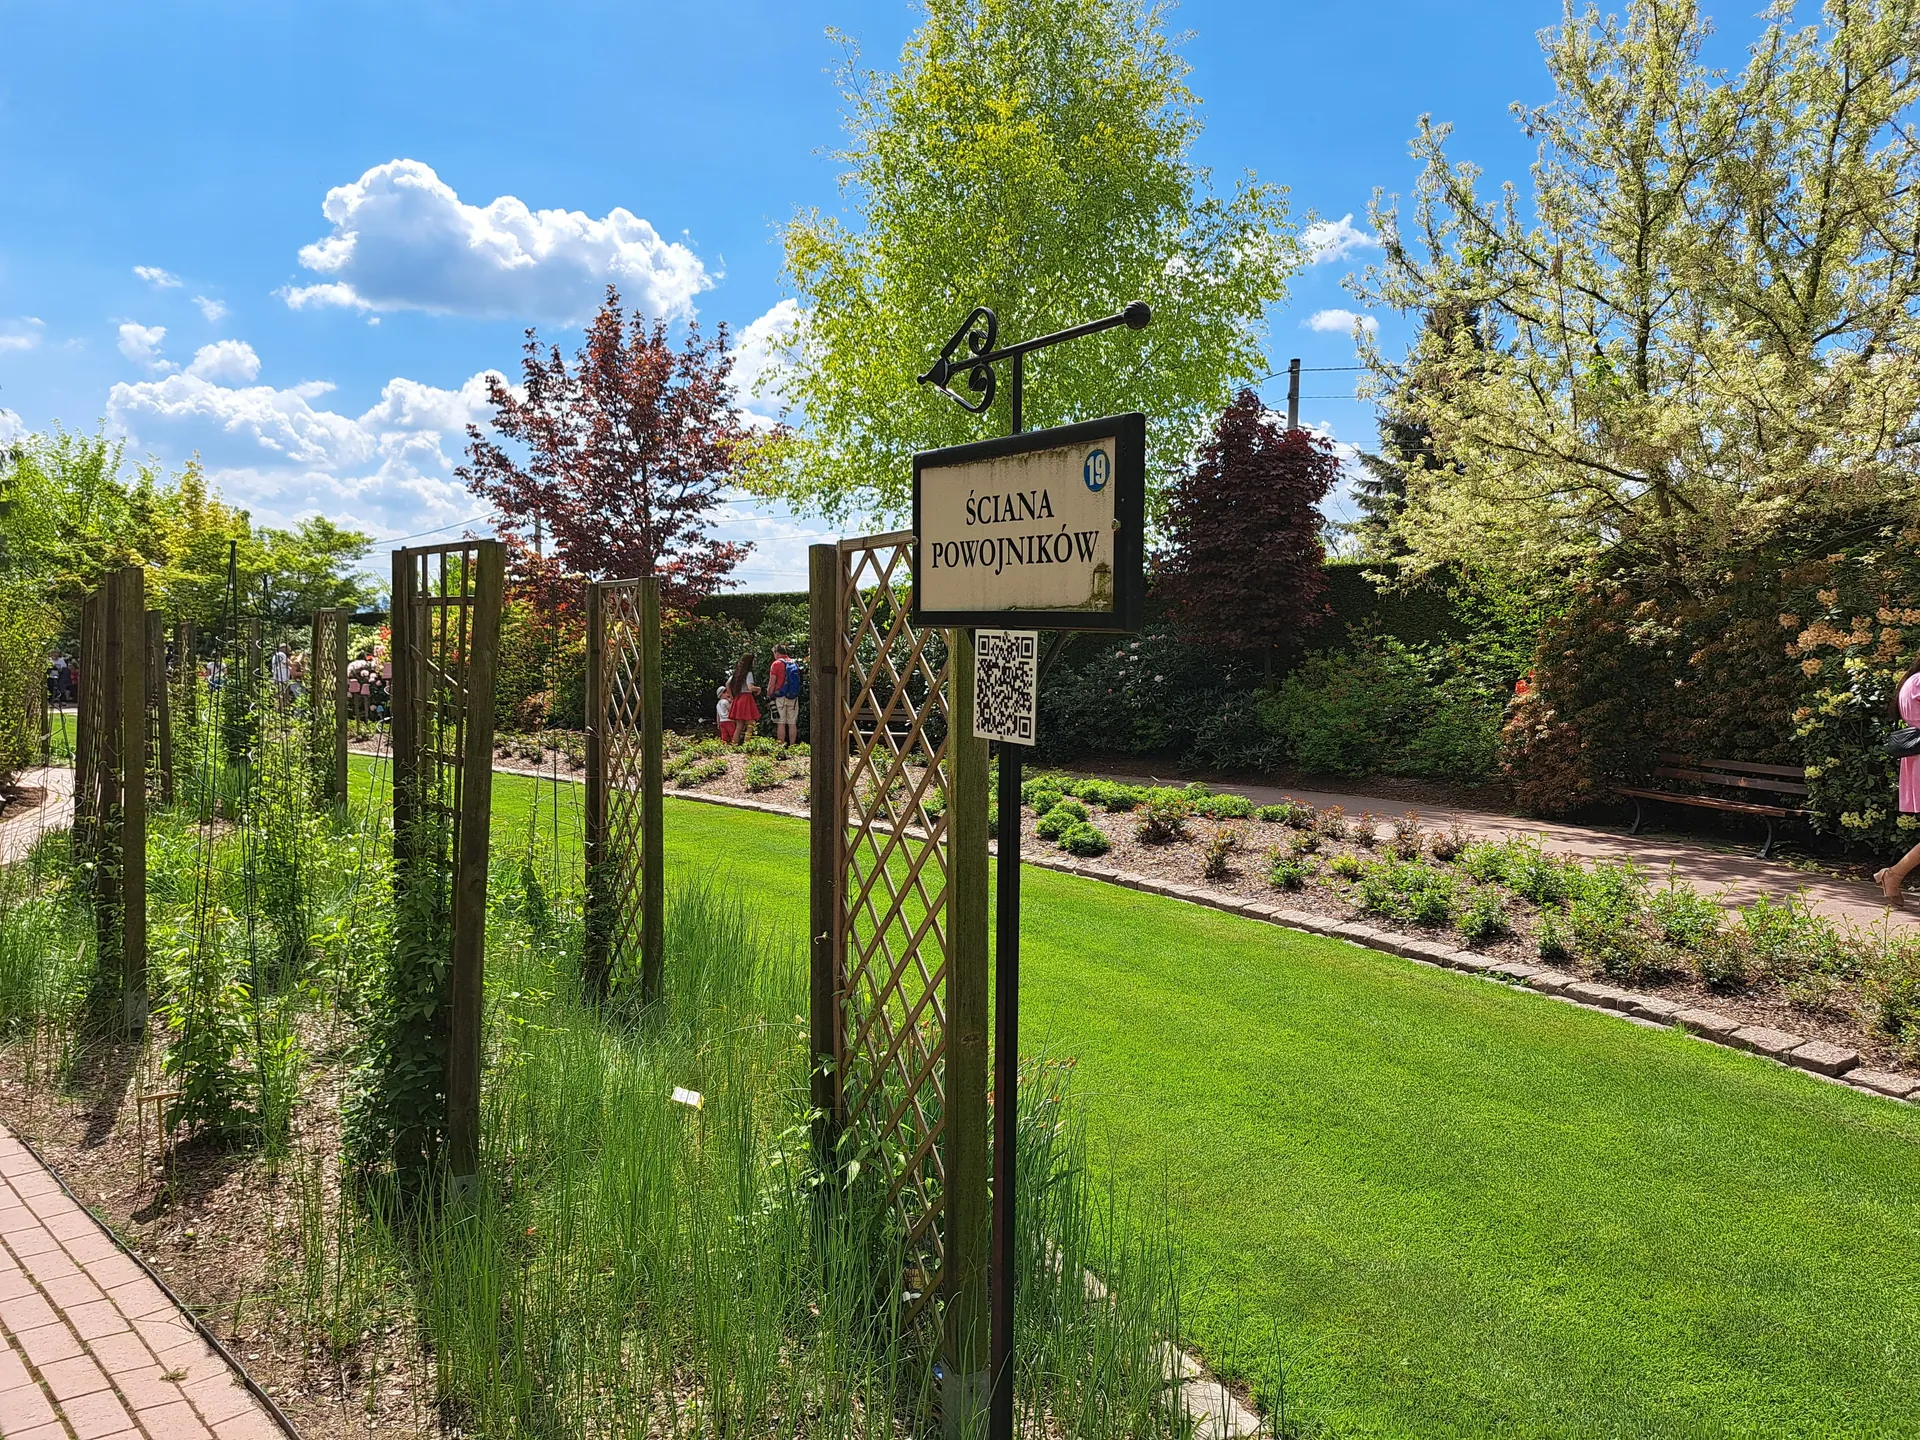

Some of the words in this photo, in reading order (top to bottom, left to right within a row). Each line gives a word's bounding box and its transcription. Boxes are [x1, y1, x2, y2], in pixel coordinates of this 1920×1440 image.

[1086, 454, 1106, 486] 19
[966, 489, 1054, 526] ŚCIANA
[931, 524, 1100, 576] POWOJNIKÓW
